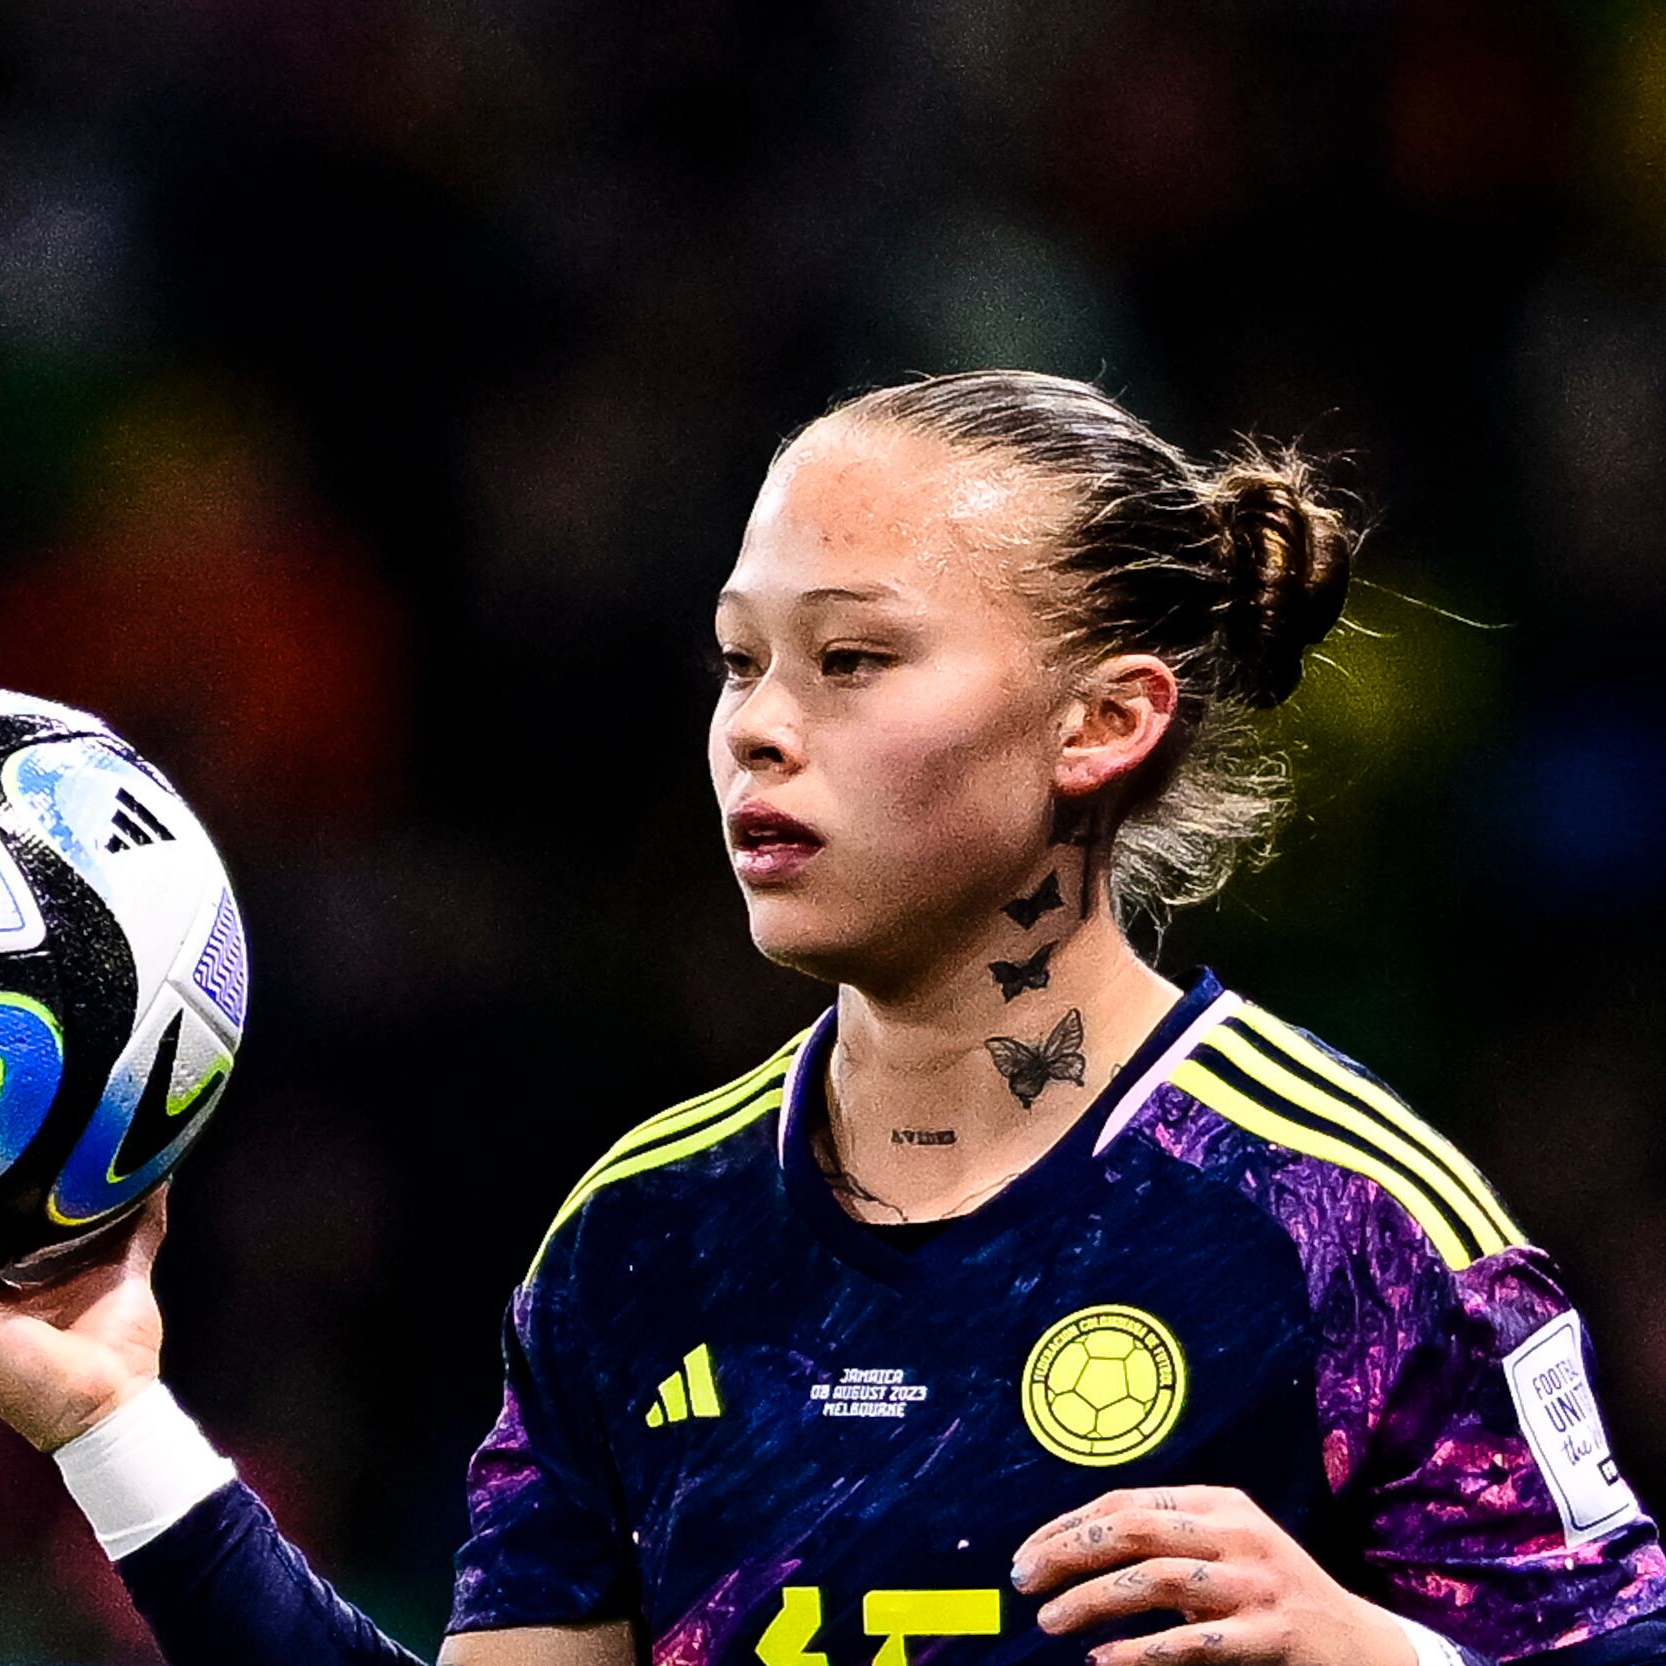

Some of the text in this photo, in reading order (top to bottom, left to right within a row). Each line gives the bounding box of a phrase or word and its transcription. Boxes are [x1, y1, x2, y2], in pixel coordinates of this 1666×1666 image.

[839, 1368, 904, 1385] JAMAICA
[810, 1384, 928, 1401] 08 AUGUST 2023
[822, 1401, 908, 1418] MELBOURNE
[1560, 1434, 1593, 1467] the
